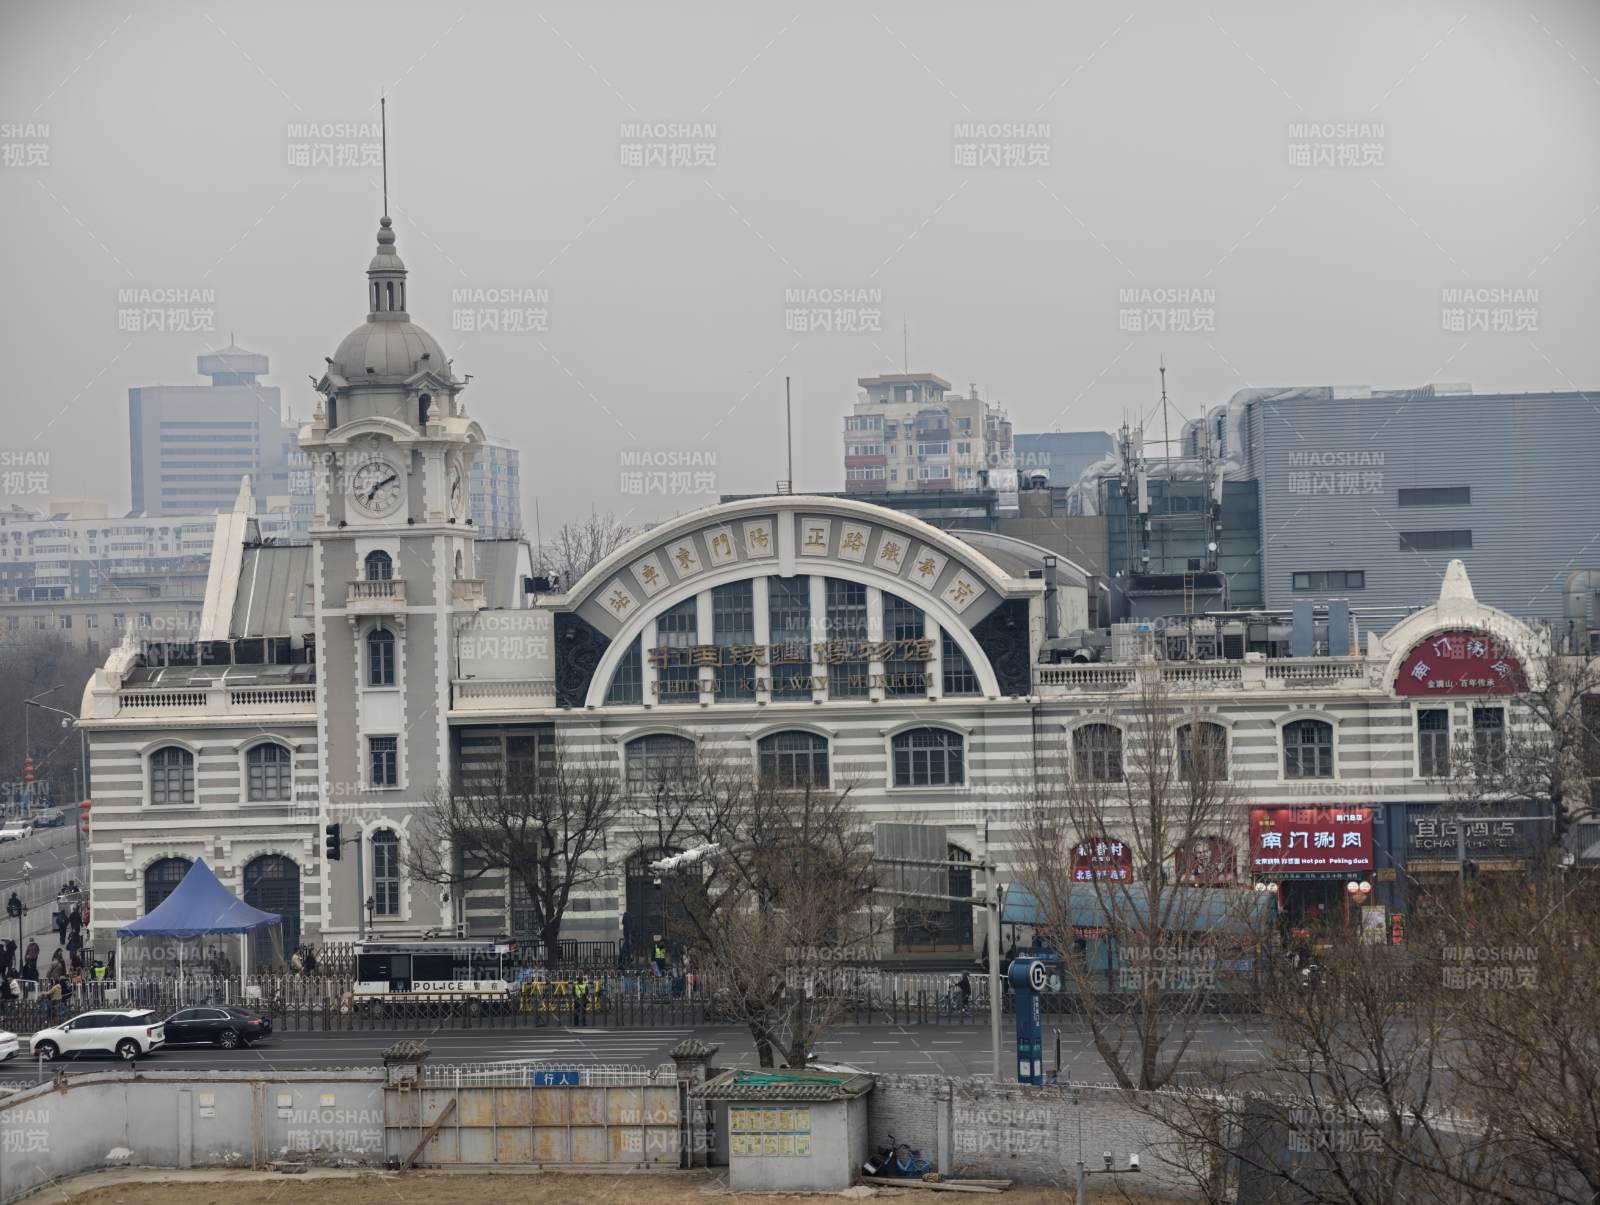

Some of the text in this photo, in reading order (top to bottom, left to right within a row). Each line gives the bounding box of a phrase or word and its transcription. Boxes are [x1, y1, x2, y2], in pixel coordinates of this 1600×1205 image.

[651, 672, 934, 696] CHINA RAILWAY MUSEUM
[1260, 831, 1362, 849] 南门涮肉
[1329, 858, 1352, 866] Peking
[413, 982, 465, 992] POLICE
[543, 1073, 569, 1086] 行人
